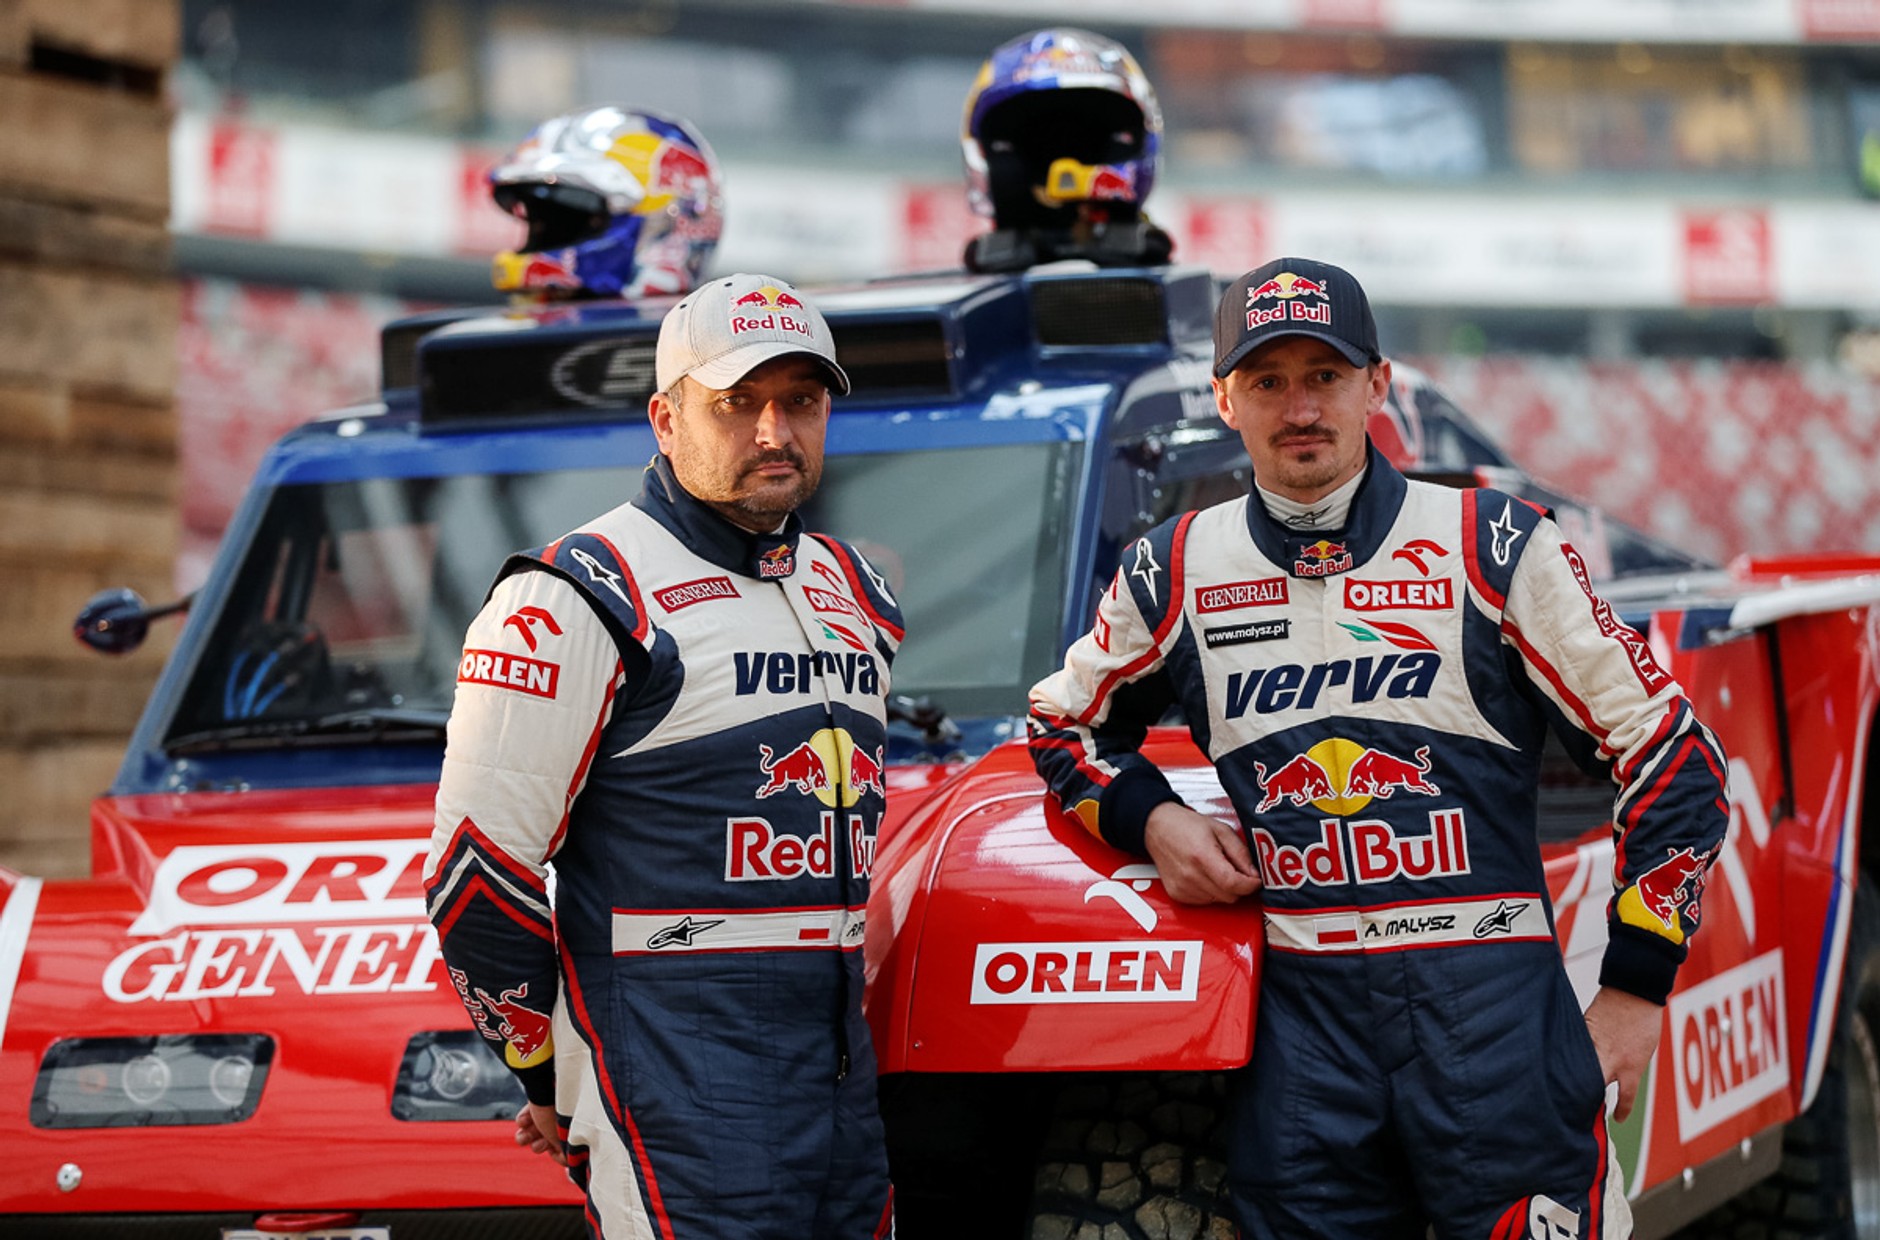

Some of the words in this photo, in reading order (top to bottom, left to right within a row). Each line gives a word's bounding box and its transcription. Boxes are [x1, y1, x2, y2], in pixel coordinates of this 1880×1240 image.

[731, 313, 775, 335] Red
[1246, 300, 1287, 331] Red
[1290, 301, 1331, 325] Bull
[759, 560, 778, 578] Red
[1294, 559, 1325, 577] Red
[1325, 552, 1353, 574] Bull
[661, 580, 736, 608] GENERALI
[1201, 582, 1285, 610] GENERALI
[1349, 582, 1447, 608] ORLEN
[1206, 622, 1285, 642] www.malysz.pl
[461, 652, 552, 693] ORLEN
[733, 649, 880, 696] verva
[1225, 652, 1443, 720] verva
[725, 810, 835, 882] Red
[848, 811, 883, 880] Bu
[1252, 818, 1349, 890] Red
[1347, 807, 1472, 885] Bull
[1385, 914, 1456, 937] MALYSZ
[984, 950, 1187, 995] ORLEN
[1682, 973, 1780, 1112] ORLEN
